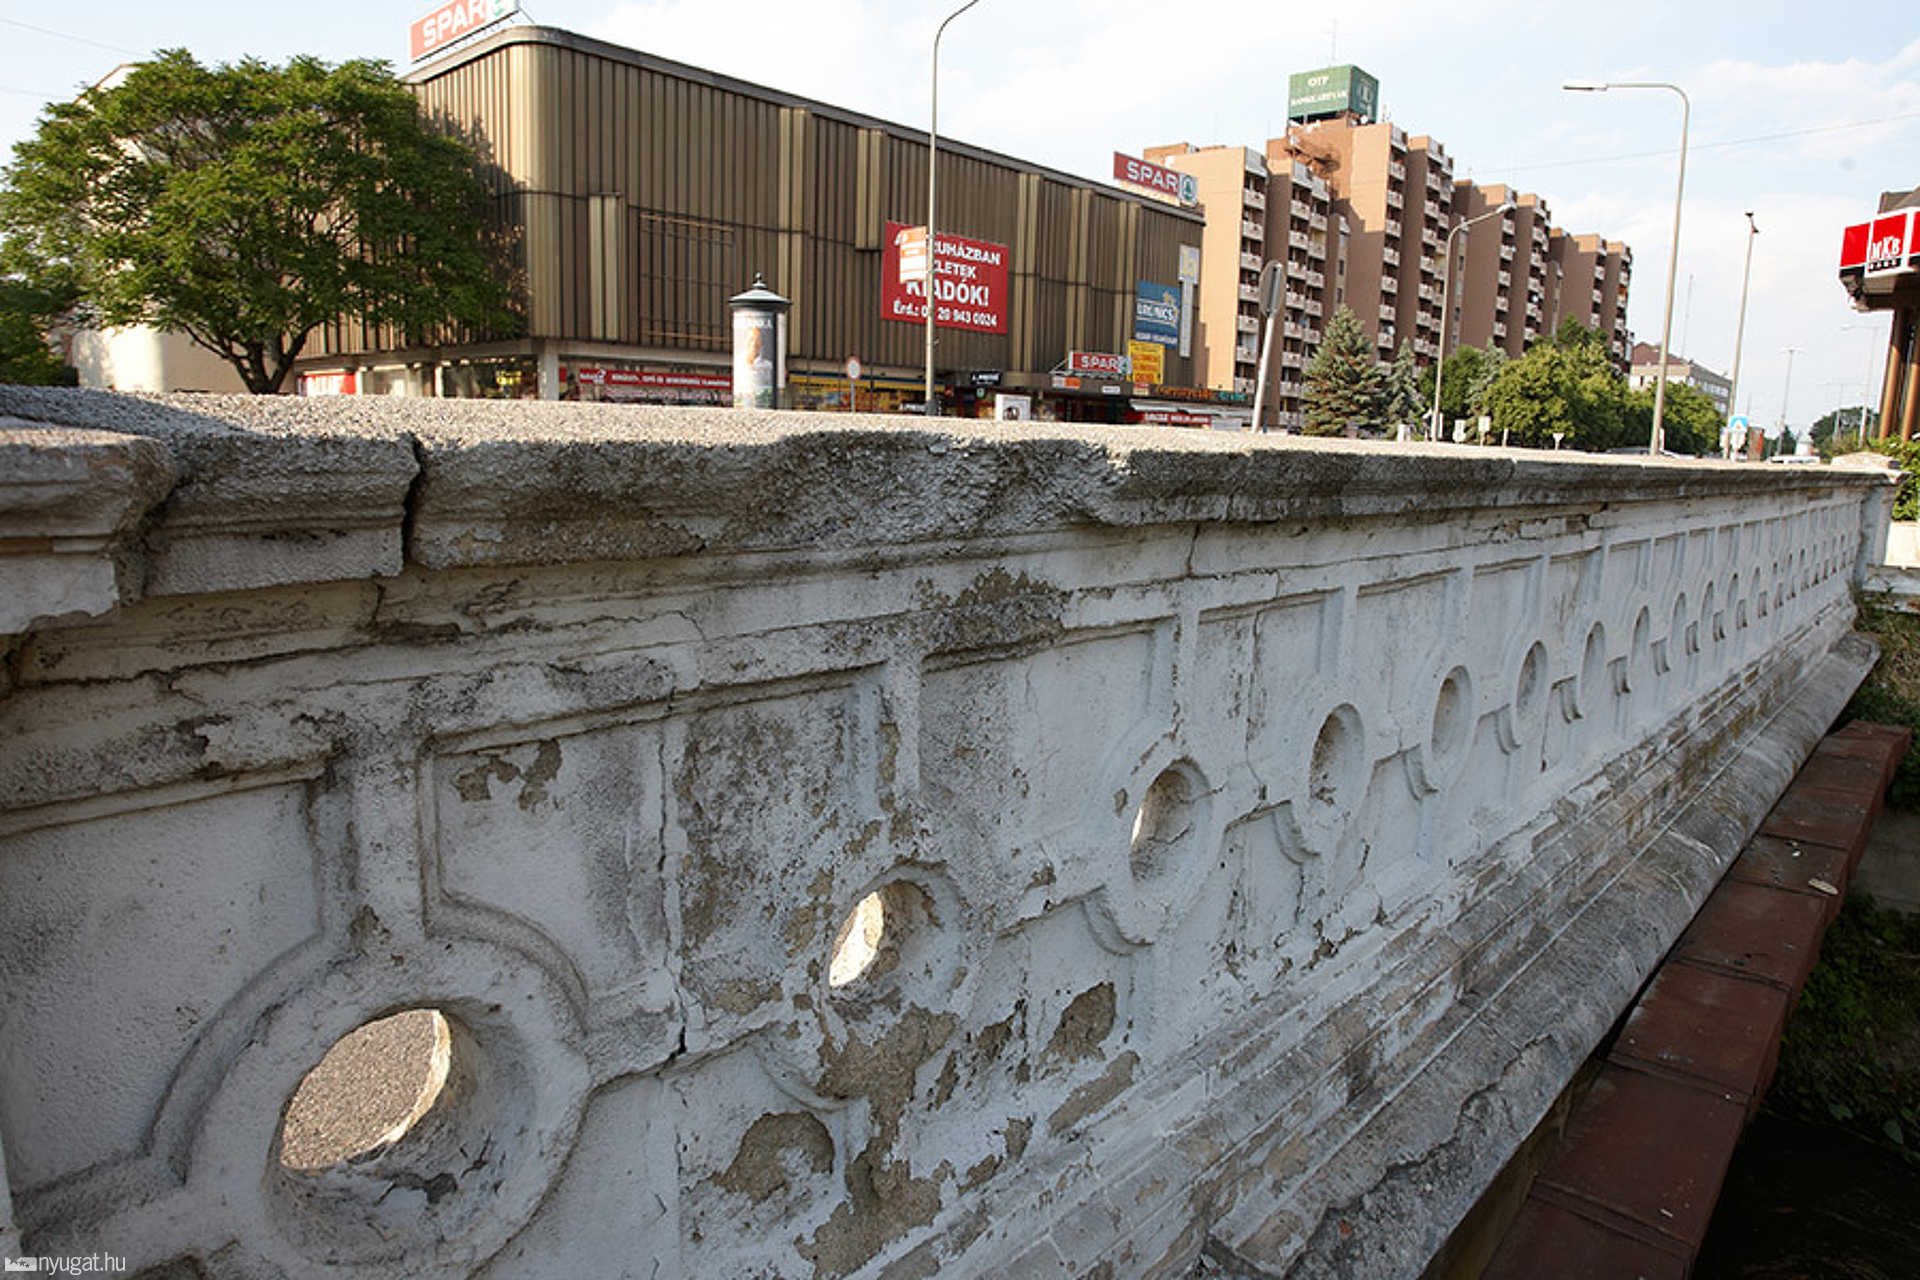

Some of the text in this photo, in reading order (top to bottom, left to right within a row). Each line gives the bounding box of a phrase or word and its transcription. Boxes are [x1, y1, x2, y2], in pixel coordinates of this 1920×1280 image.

[423, 0, 484, 48] SPAR
[1127, 160, 1178, 193] SPAR
[1872, 236, 1900, 259] MKB
[1081, 355, 1118, 371] SPAR
